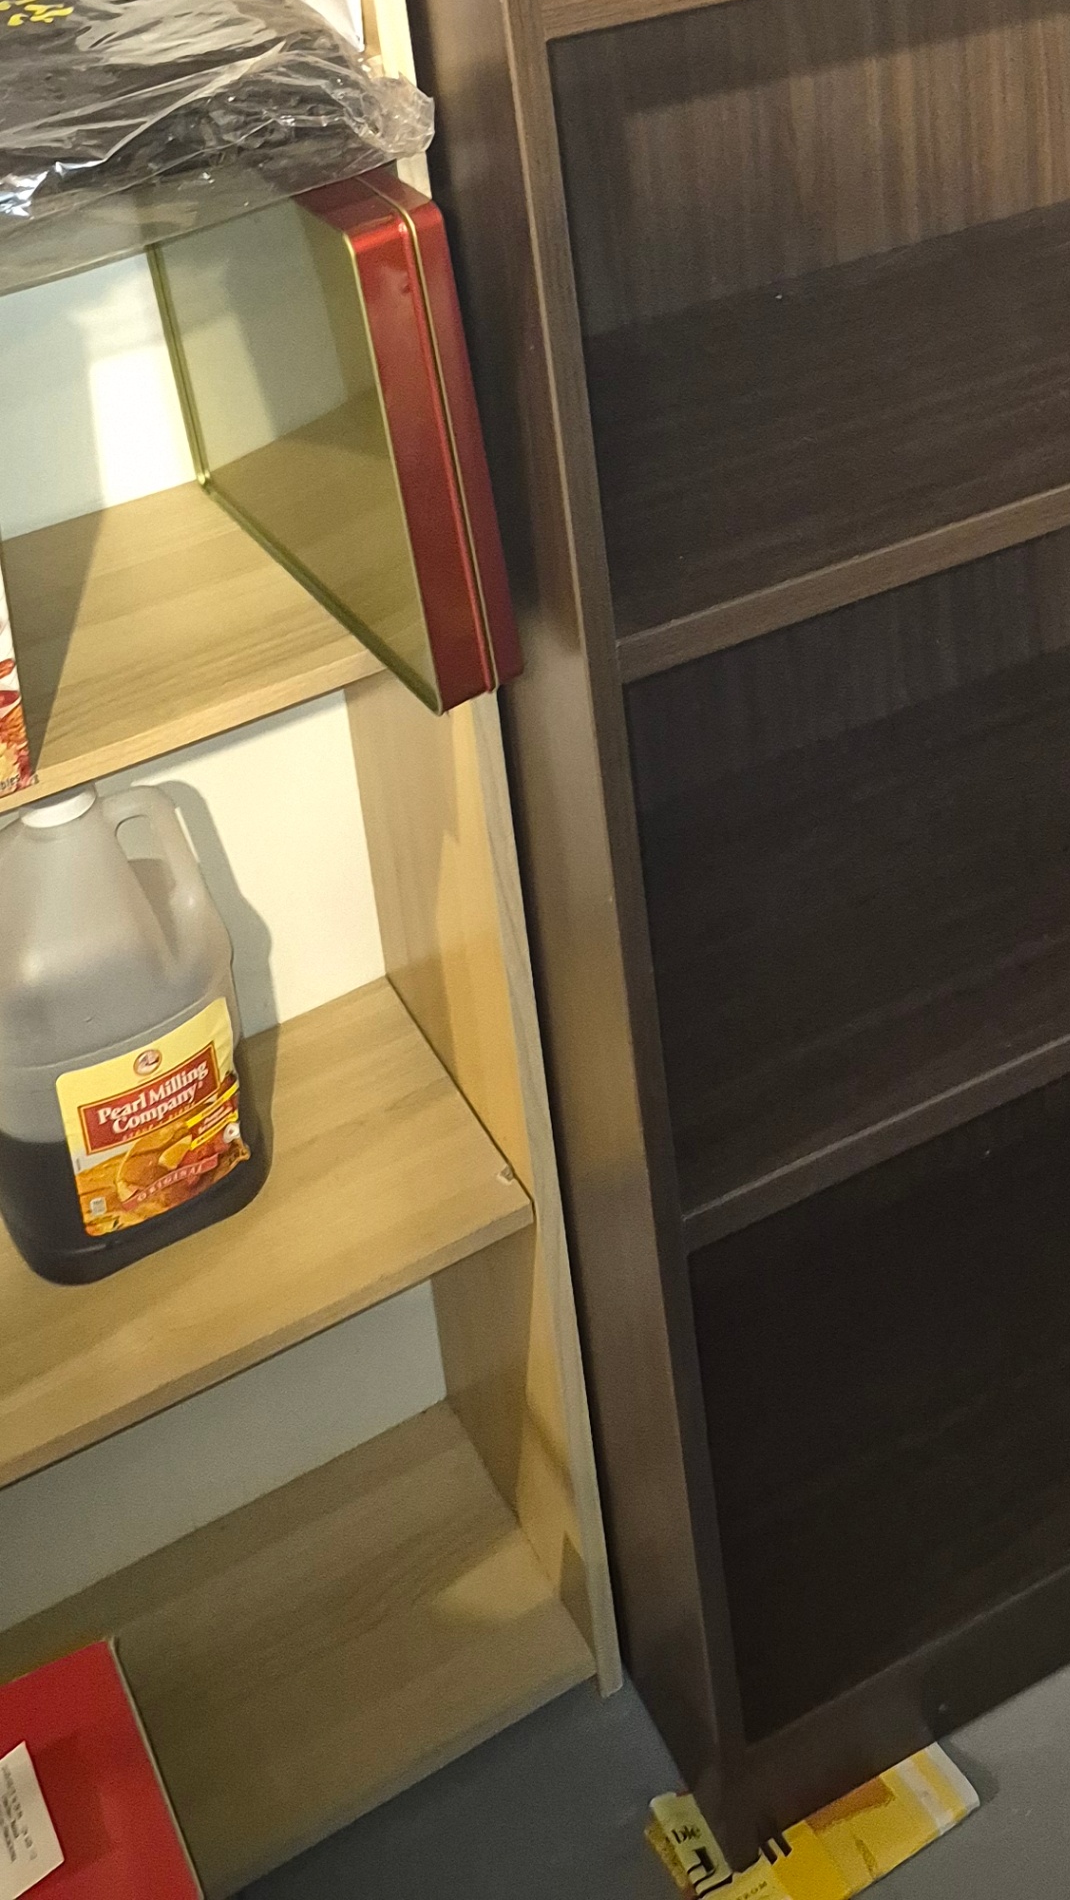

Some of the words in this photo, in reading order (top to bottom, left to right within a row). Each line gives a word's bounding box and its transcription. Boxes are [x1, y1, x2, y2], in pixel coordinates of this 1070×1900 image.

[97, 1093, 147, 1125] Pearl
[149, 1059, 209, 1105] Milling
[112, 1081, 198, 1134] Company
